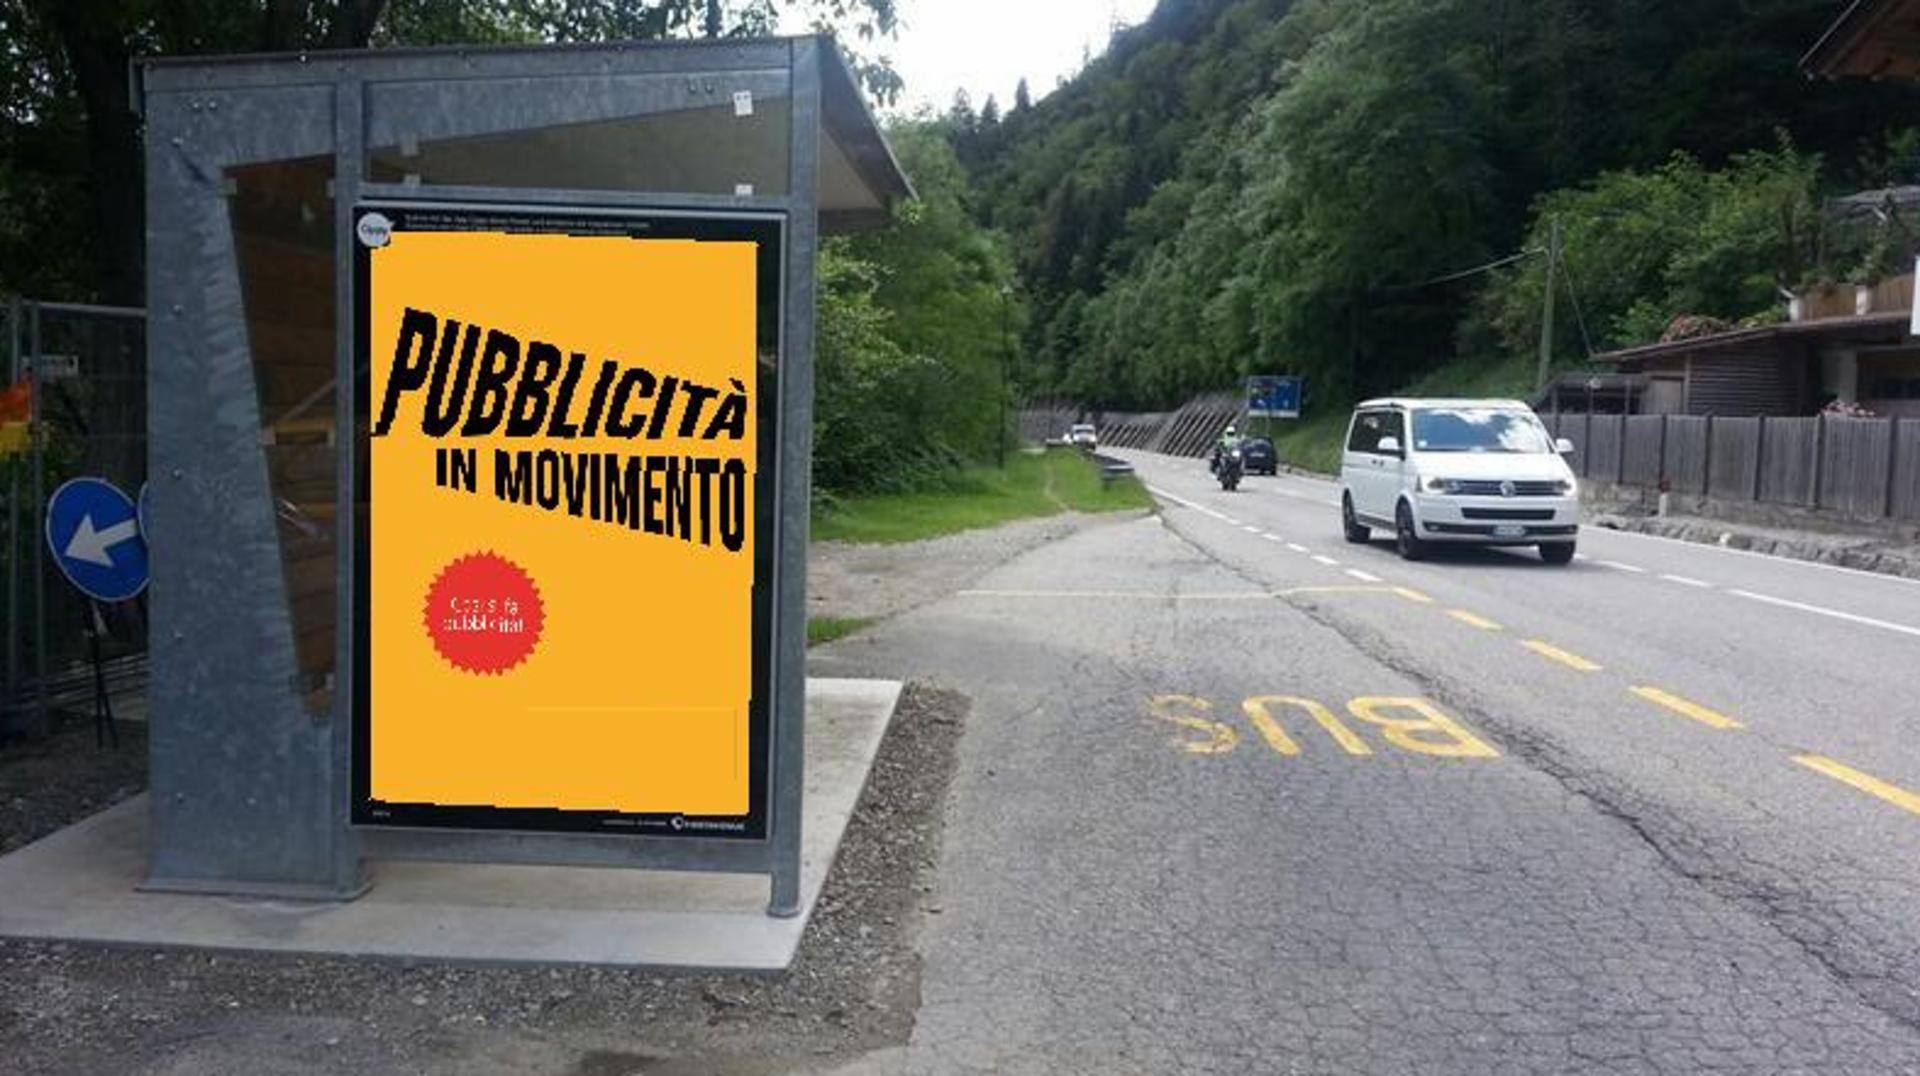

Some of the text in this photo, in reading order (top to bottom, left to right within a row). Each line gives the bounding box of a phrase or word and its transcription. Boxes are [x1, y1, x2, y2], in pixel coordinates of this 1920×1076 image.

[371, 307, 747, 439] PUBBLICITÀ
[436, 448, 746, 552] IN MOVIMENTO
[443, 613, 524, 632] pubblcità!
[1150, 694, 1502, 757] BUS
